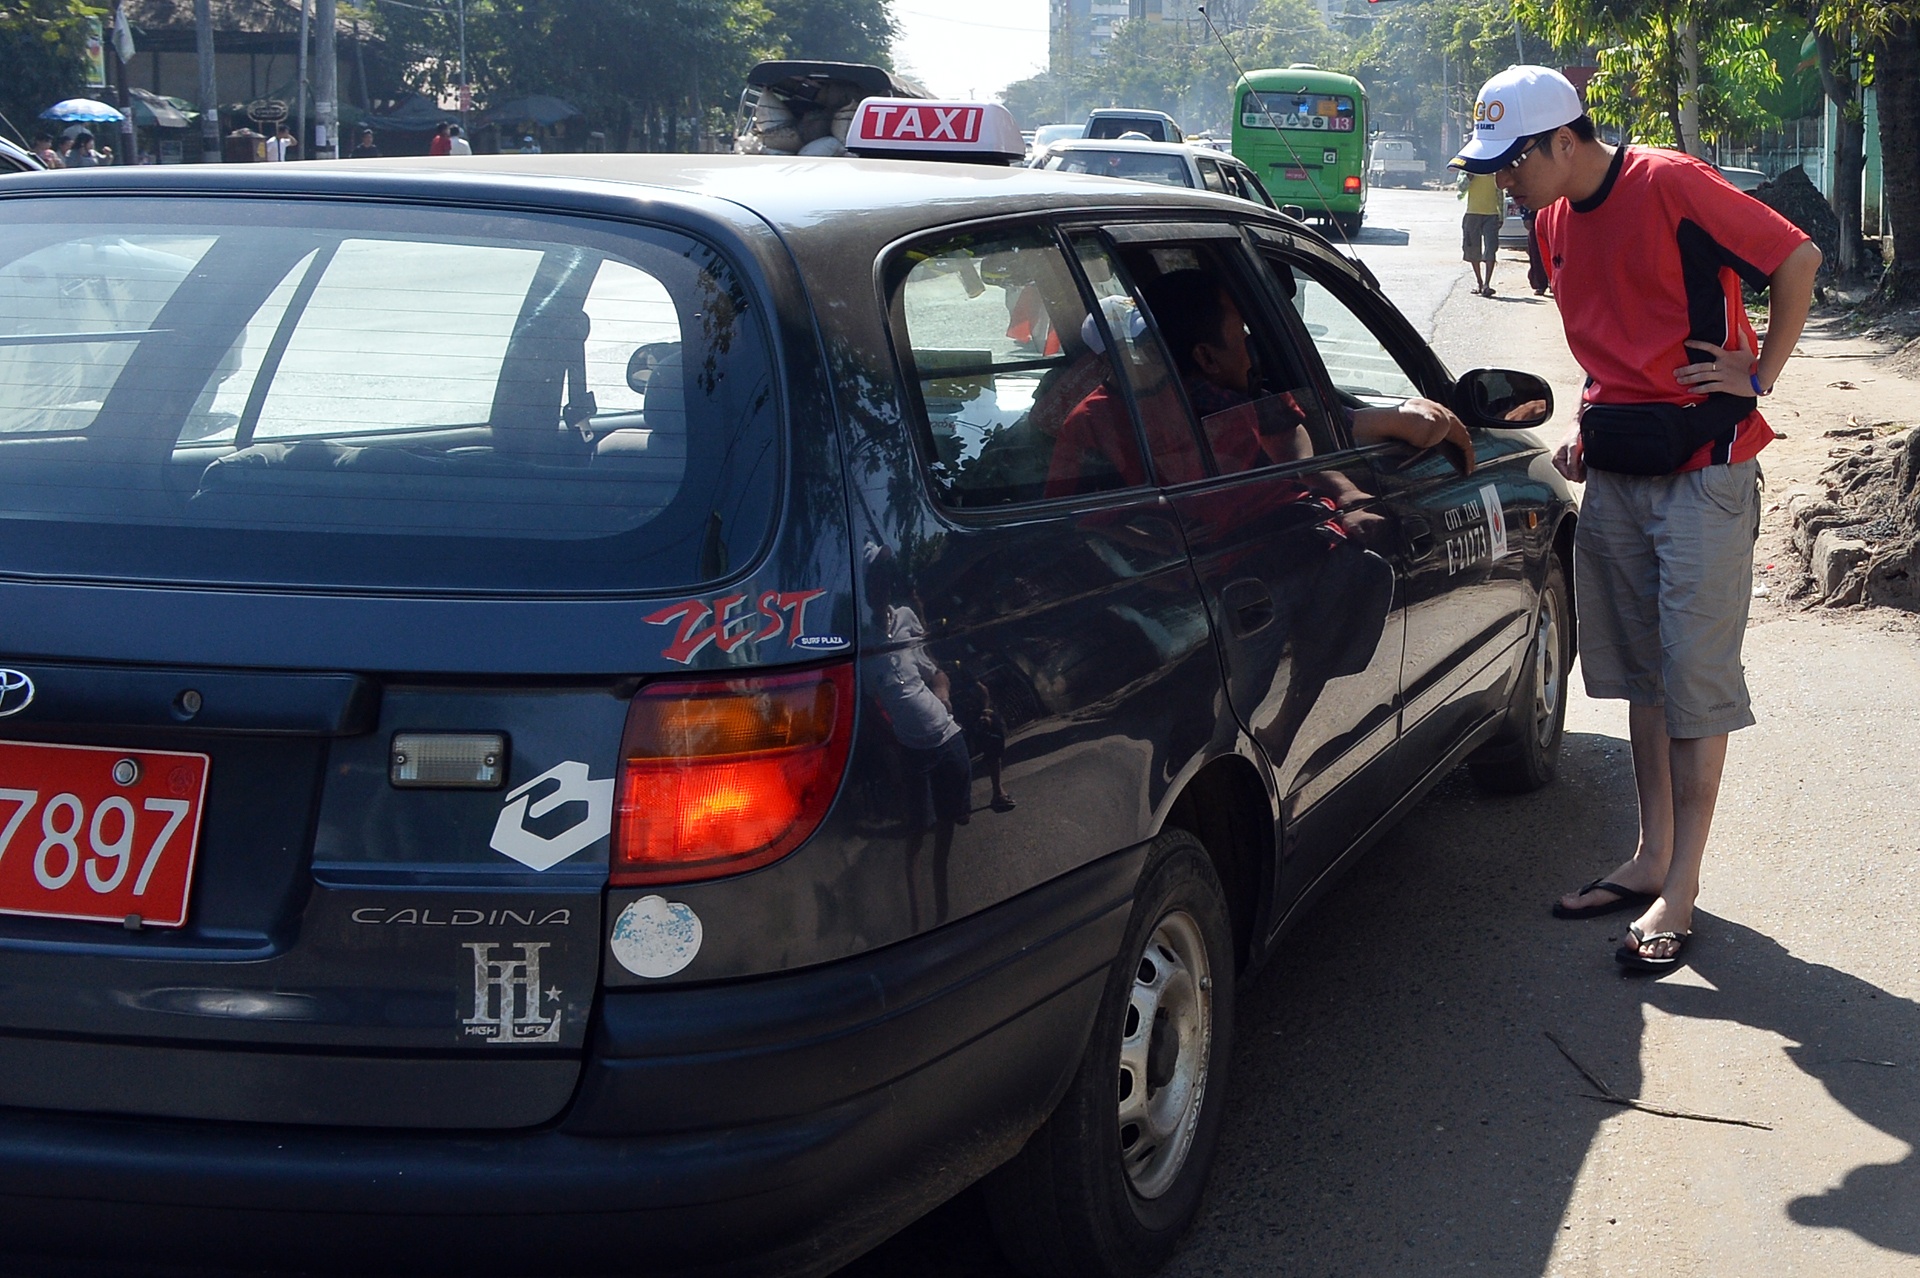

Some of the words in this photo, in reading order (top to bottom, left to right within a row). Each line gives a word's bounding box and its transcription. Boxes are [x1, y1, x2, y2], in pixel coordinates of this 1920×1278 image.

[868, 106, 977, 140] TAXI
[1334, 117, 1350, 130] 13
[1444, 508, 1462, 531] CITY
[1462, 500, 1480, 522] TAXI
[641, 588, 827, 664] ZEST
[801, 636, 820, 645] SURF
[821, 636, 843, 644] PLAZA
[0, 788, 190, 896] 7897
[351, 908, 571, 926] CALDINA
[465, 1026, 497, 1035] HIGH
